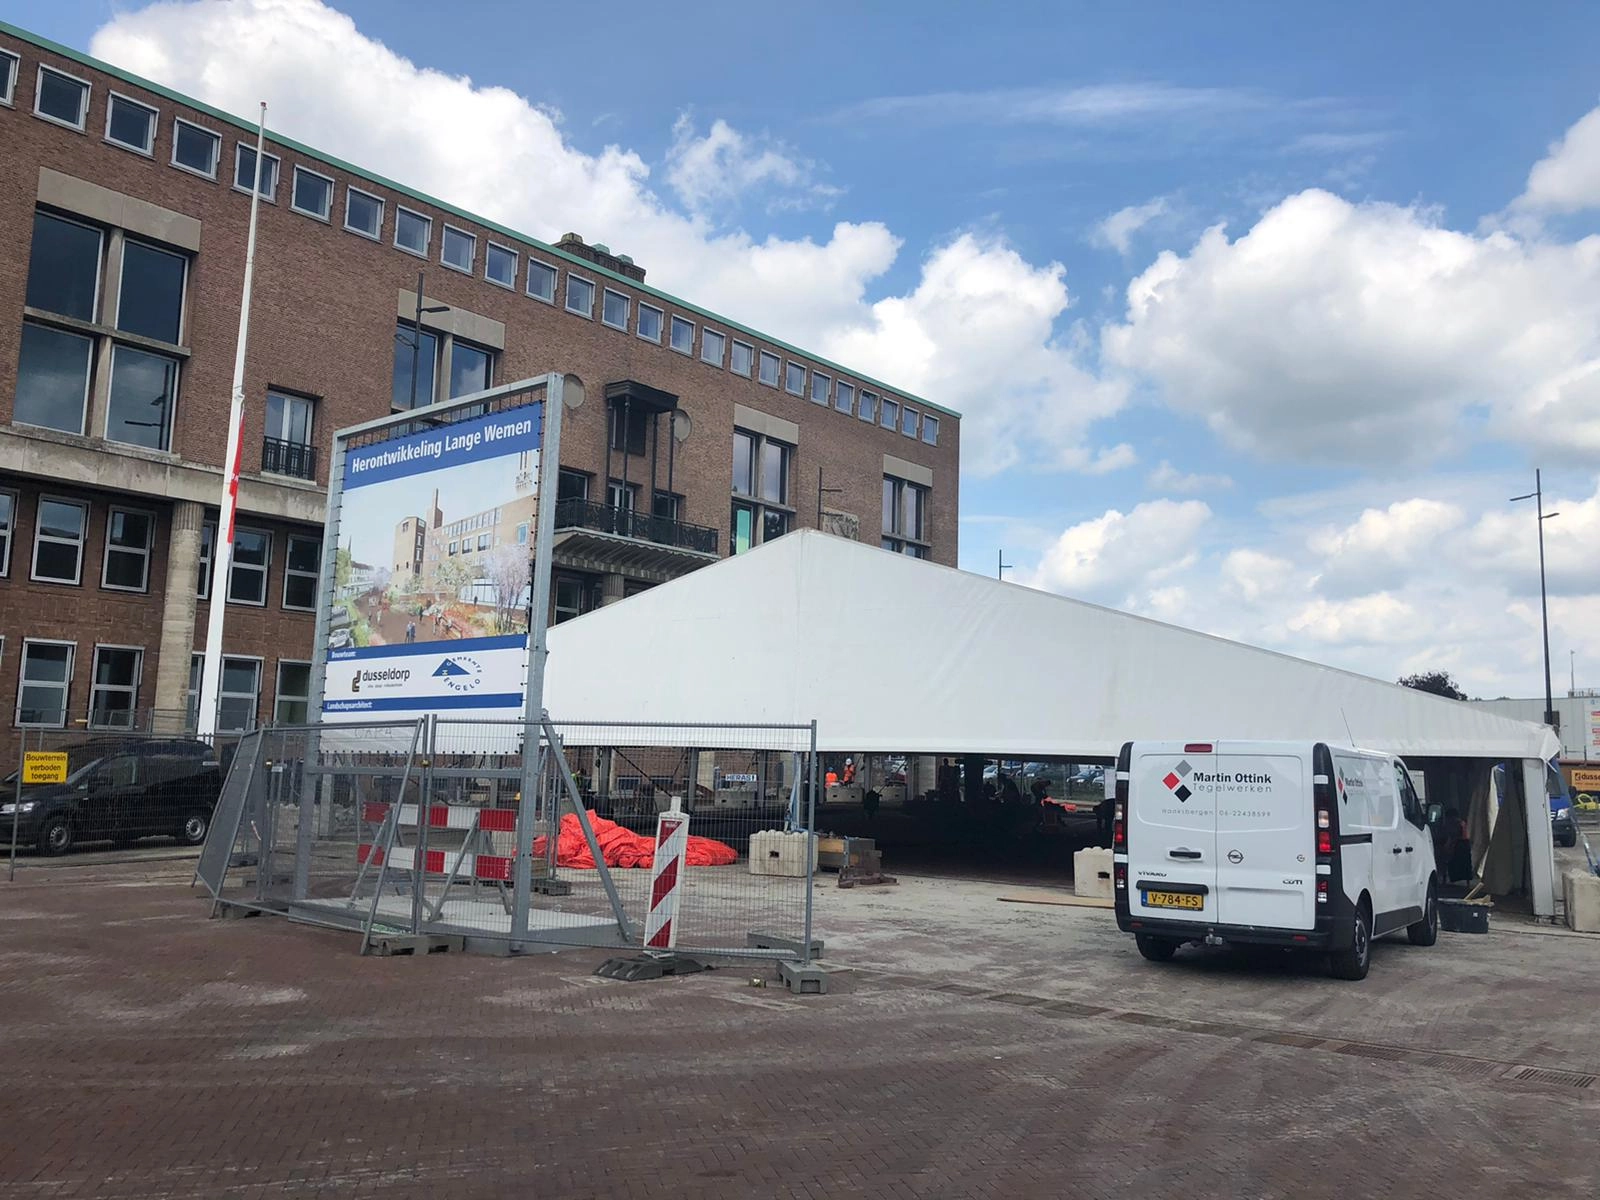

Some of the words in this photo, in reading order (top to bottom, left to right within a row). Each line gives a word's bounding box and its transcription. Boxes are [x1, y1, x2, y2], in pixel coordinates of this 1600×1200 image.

[351, 441, 442, 473] Herontwikkeling
[445, 431, 481, 453] Lange
[484, 419, 532, 442] Wemen
[362, 668, 411, 682] dusseldorp
[26, 753, 67, 762] Bouwterrein
[31, 773, 59, 781] toegang
[1193, 772, 1232, 783] Martin
[1234, 773, 1272, 784] Ottink
[1193, 783, 1272, 793] Tegelwerken
[1151, 893, 1199, 907] V-784-FS
